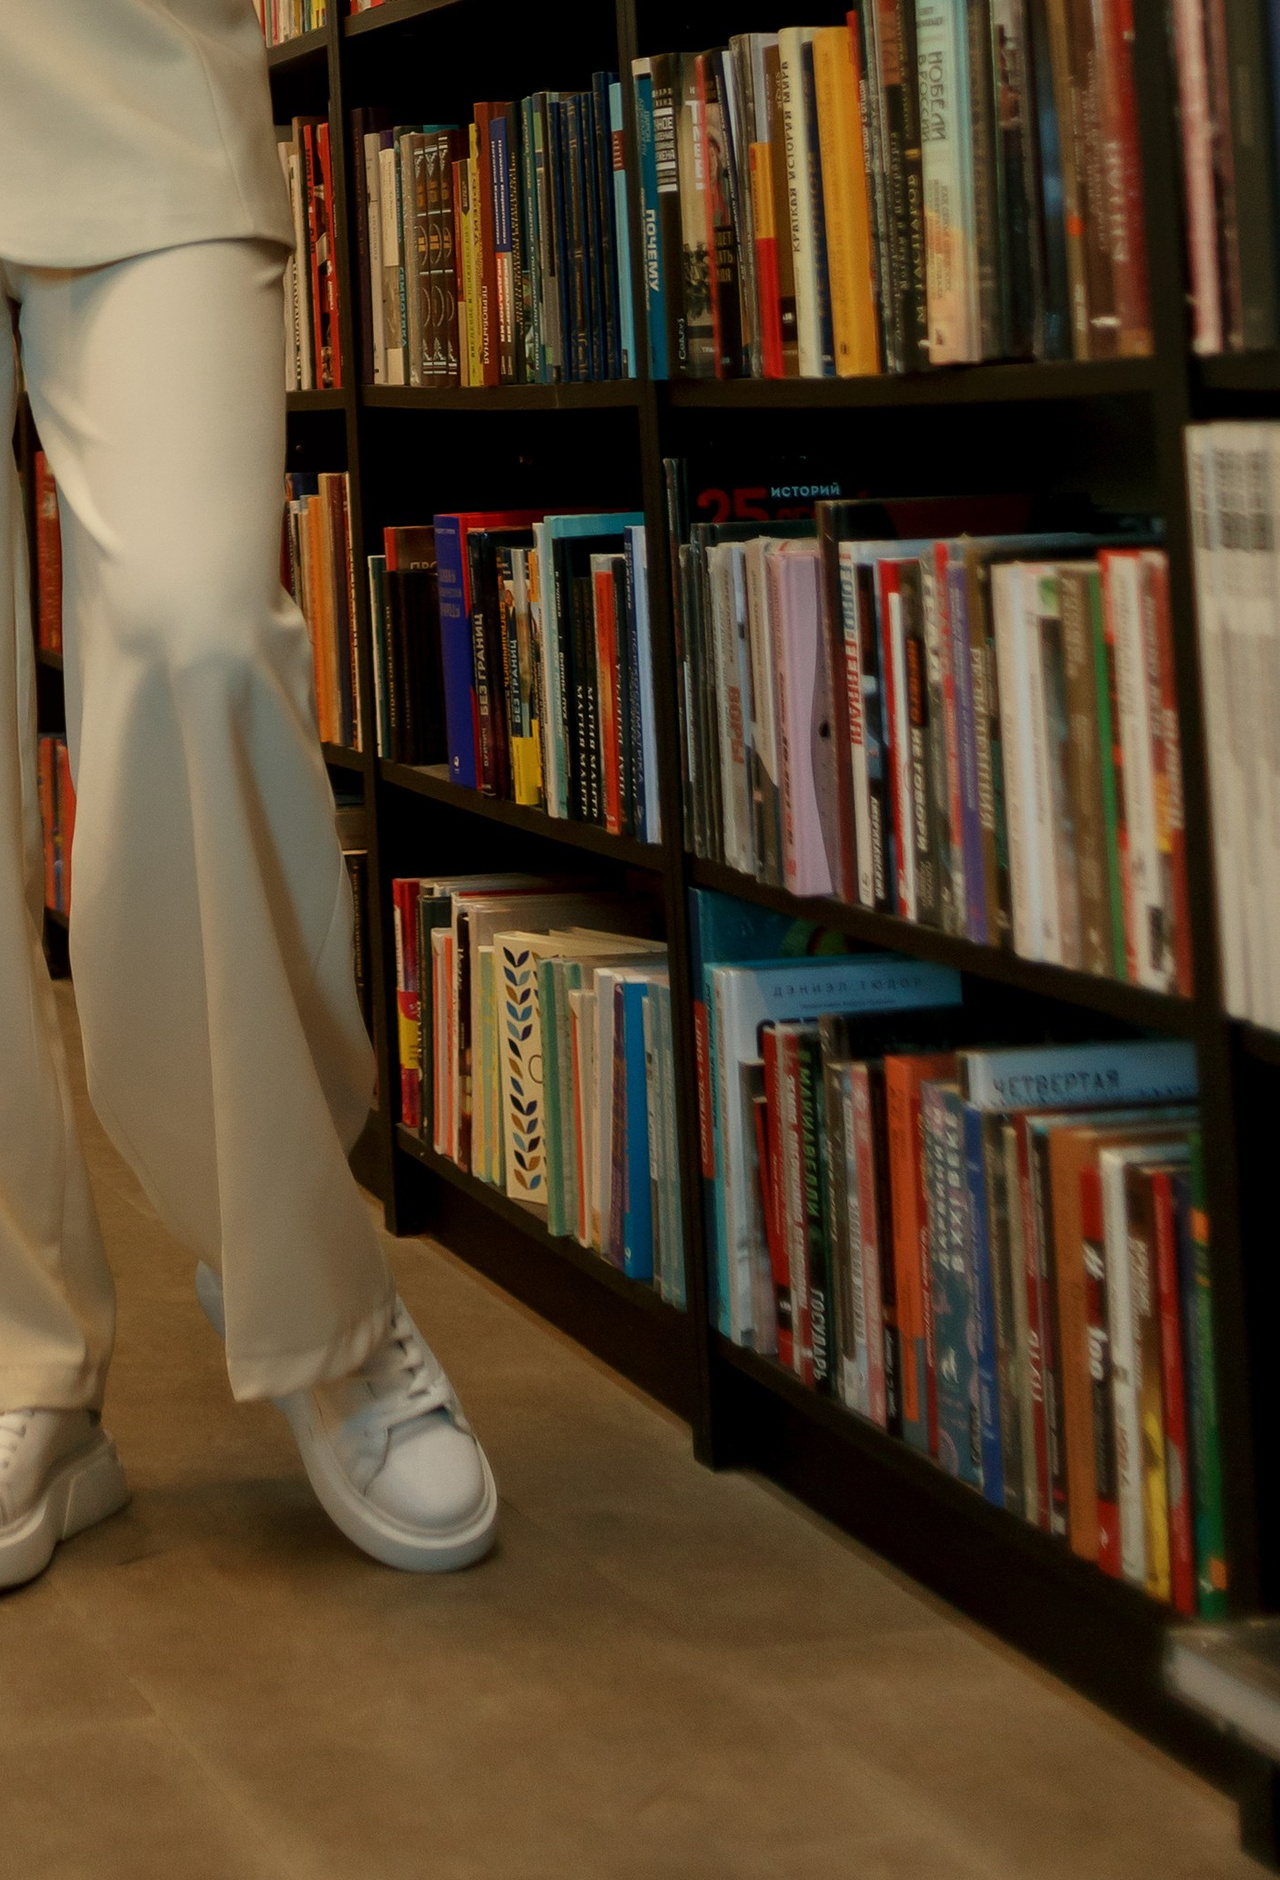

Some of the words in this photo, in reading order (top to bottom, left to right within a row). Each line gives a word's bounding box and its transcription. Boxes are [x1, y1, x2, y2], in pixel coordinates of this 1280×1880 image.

[781, 61, 790, 103] МИРА
[928, 51, 946, 141] НОБЕЛИ
[785, 110, 796, 180] ИСТОРИЯ
[646, 209, 659, 291] ПОЧЕМУ
[789, 187, 800, 253] КРАТКАЯ
[399, 266, 407, 347] СЕМИОТИКА
[482, 285, 490, 364] ПЕРВОБЫТНАЯ
[497, 258, 505, 343] МЕДИАЛОГИЯ
[504, 258, 512, 343] МЕДИАЛОГИЯ
[697, 487, 770, 522] 25
[770, 482, 841, 498] ИСТОРИЙ
[840, 564, 856, 630] FORD
[474, 613, 486, 680] ГРАНИЦ
[510, 639, 519, 694] ГРАНИЦ
[479, 685, 489, 716] БЕЗ
[577, 685, 585, 747] МАГИЯ
[587, 686, 596, 749] МАГИЯ
[728, 685, 744, 764] ВОРЫ
[846, 639, 862, 745] FERRARI
[912, 728, 923, 757] НЕ
[580, 752, 588, 816] МАНТР
[590, 754, 598, 818] МАНТР
[913, 761, 927, 852] ГОВОРИ
[773, 979, 848, 997] ДЭНИЭЛ
[859, 976, 922, 993] ТЮДОР
[993, 1069, 1120, 1098] ЧЕТВЕРТАЯ
[800, 1067, 819, 1217] МАКИАВЕЛЛИ
[811, 1288, 826, 1380] ГОСУДАРЬ
